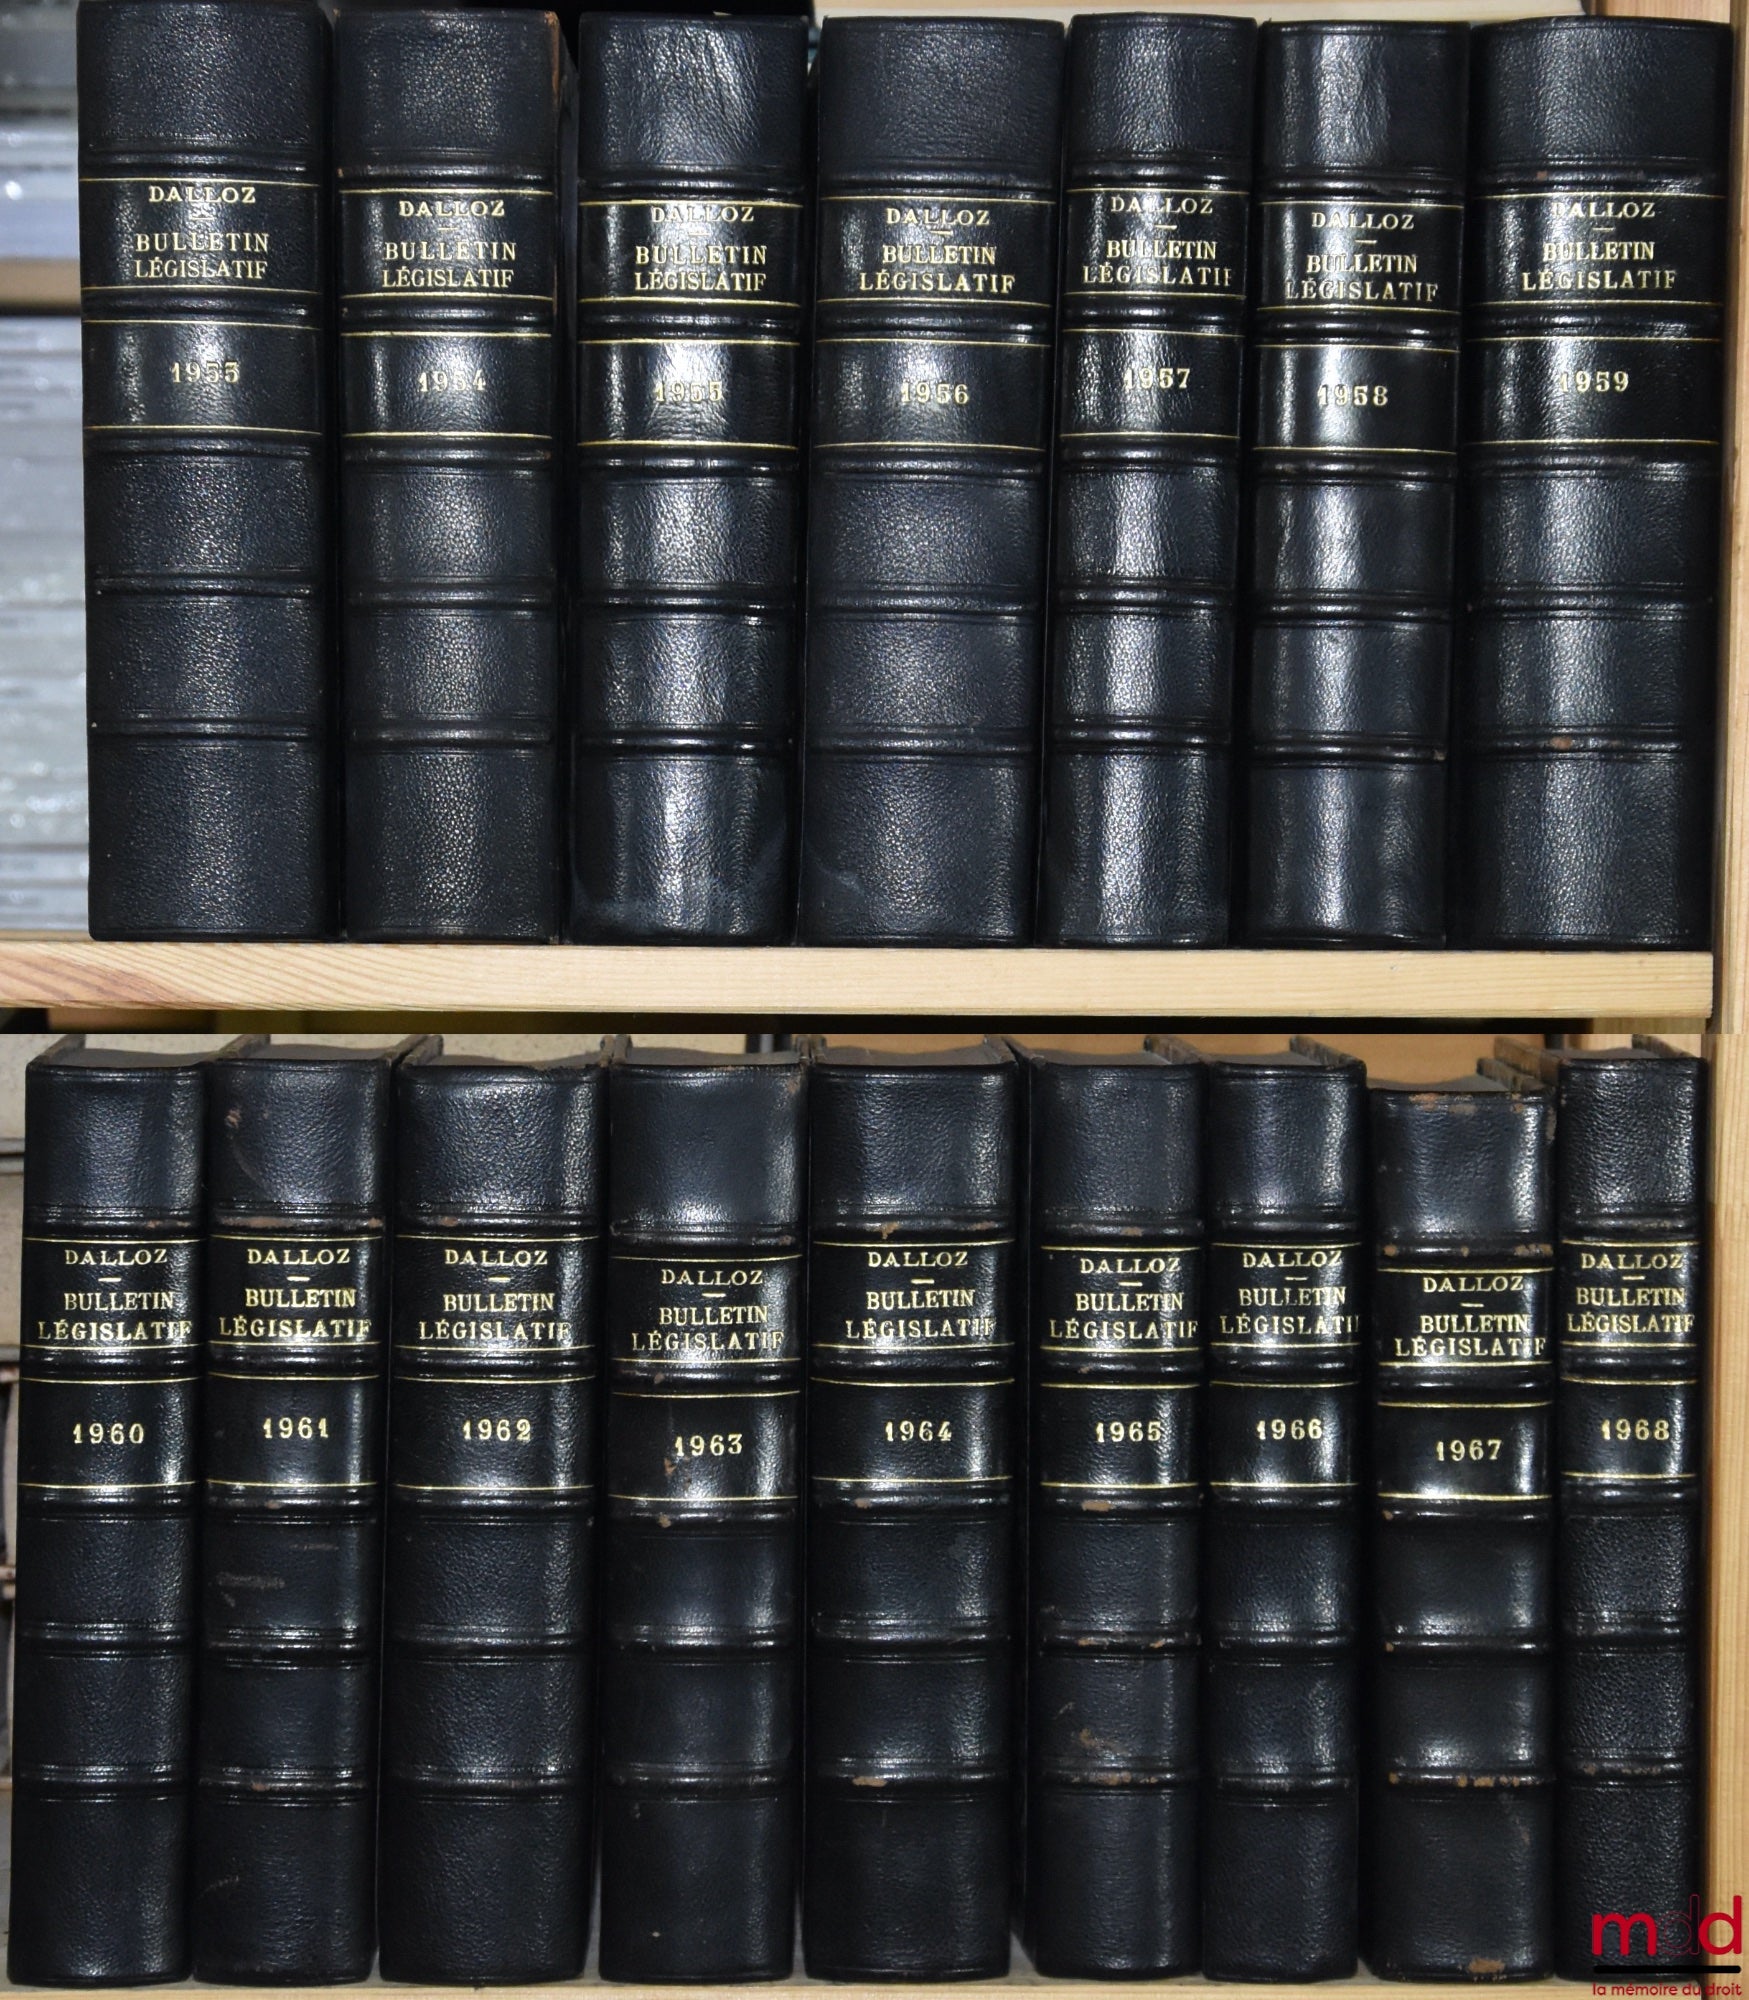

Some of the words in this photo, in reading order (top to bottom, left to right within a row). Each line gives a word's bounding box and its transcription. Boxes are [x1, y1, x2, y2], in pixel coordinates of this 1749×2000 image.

[149, 187, 256, 203] DALLOZ
[399, 200, 505, 217] DALLOZ
[1111, 196, 1213, 214] DALLOZ
[1553, 202, 1655, 218] DALLOZ
[651, 207, 754, 223] DALLOZ
[887, 208, 990, 225] DALLOZ
[1312, 212, 1414, 230] DALLOZ
[135, 233, 269, 252] BULLETIN
[384, 242, 516, 261] BULLETIN
[1107, 240, 1217, 260] BULLETIN
[1543, 242, 1655, 261] BULLETIN
[635, 246, 767, 264] BULLETIN
[882, 244, 997, 264] BULLETIN
[1307, 254, 1416, 273] BULLETIN
[135, 257, 268, 279] LÉGISLATIF
[382, 266, 514, 288] LÉGISLATIF
[635, 268, 766, 291] LÉGISLATIF
[859, 269, 1015, 293] LÉGISLATIF
[1522, 270, 1677, 291] LÉGISLATIF
[1285, 278, 1438, 301] LÉGISLATIF
[418, 370, 487, 392] 1954
[1124, 368, 1190, 389] 1957
[1560, 371, 1629, 392] 1959
[655, 381, 723, 402] 1955
[901, 383, 969, 404] 1956
[1317, 384, 1388, 406] 1958
[65, 1249, 167, 1265] DALLOZ
[248, 1249, 350, 1264] DALLOZ
[445, 1250, 548, 1265] DALLOZ
[868, 1252, 968, 1267] DALLOZ
[1081, 1258, 1180, 1274] DALLOZ
[1243, 1251, 1342, 1268] DALLOZ
[1581, 1253, 1683, 1269] DALLOZ
[661, 1269, 763, 1285] DALLOZ
[1423, 1277, 1523, 1292] DALLOZ
[64, 1292, 174, 1311] BULLETIN
[246, 1289, 356, 1308] BULLETIN
[443, 1293, 555, 1312] BULLETIN
[866, 1290, 975, 1309] BULLETIN
[1076, 1293, 1183, 1311] BULLETIN
[1239, 1287, 1346, 1306] BULLETIN
[1576, 1288, 1686, 1306] BULLETIN
[660, 1306, 768, 1325] BULLETIN
[1420, 1314, 1529, 1333] BULLETIN
[1568, 1313, 1695, 1333] LÉGISLATIF
[38, 1320, 192, 1340] LÉGISLATIF
[219, 1316, 371, 1337] LÉGISLATIF
[419, 1320, 572, 1339] LÉGISLATIF
[846, 1318, 996, 1338] LÉGISLATIF
[1050, 1318, 1198, 1339] LÉGISLATIF
[632, 1331, 784, 1351] LÉGISLATIF
[1395, 1336, 1546, 1357] LÉGISLATIF
[73, 1424, 144, 1444] 1960
[263, 1417, 329, 1439] 1961
[463, 1419, 531, 1441] 1962
[885, 1421, 952, 1441] 1964
[1096, 1422, 1162, 1442] 1965
[1257, 1419, 1322, 1440] 1966
[1602, 1419, 1670, 1440] 1968
[675, 1434, 742, 1456] 1963
[1437, 1440, 1502, 1461] 1967
